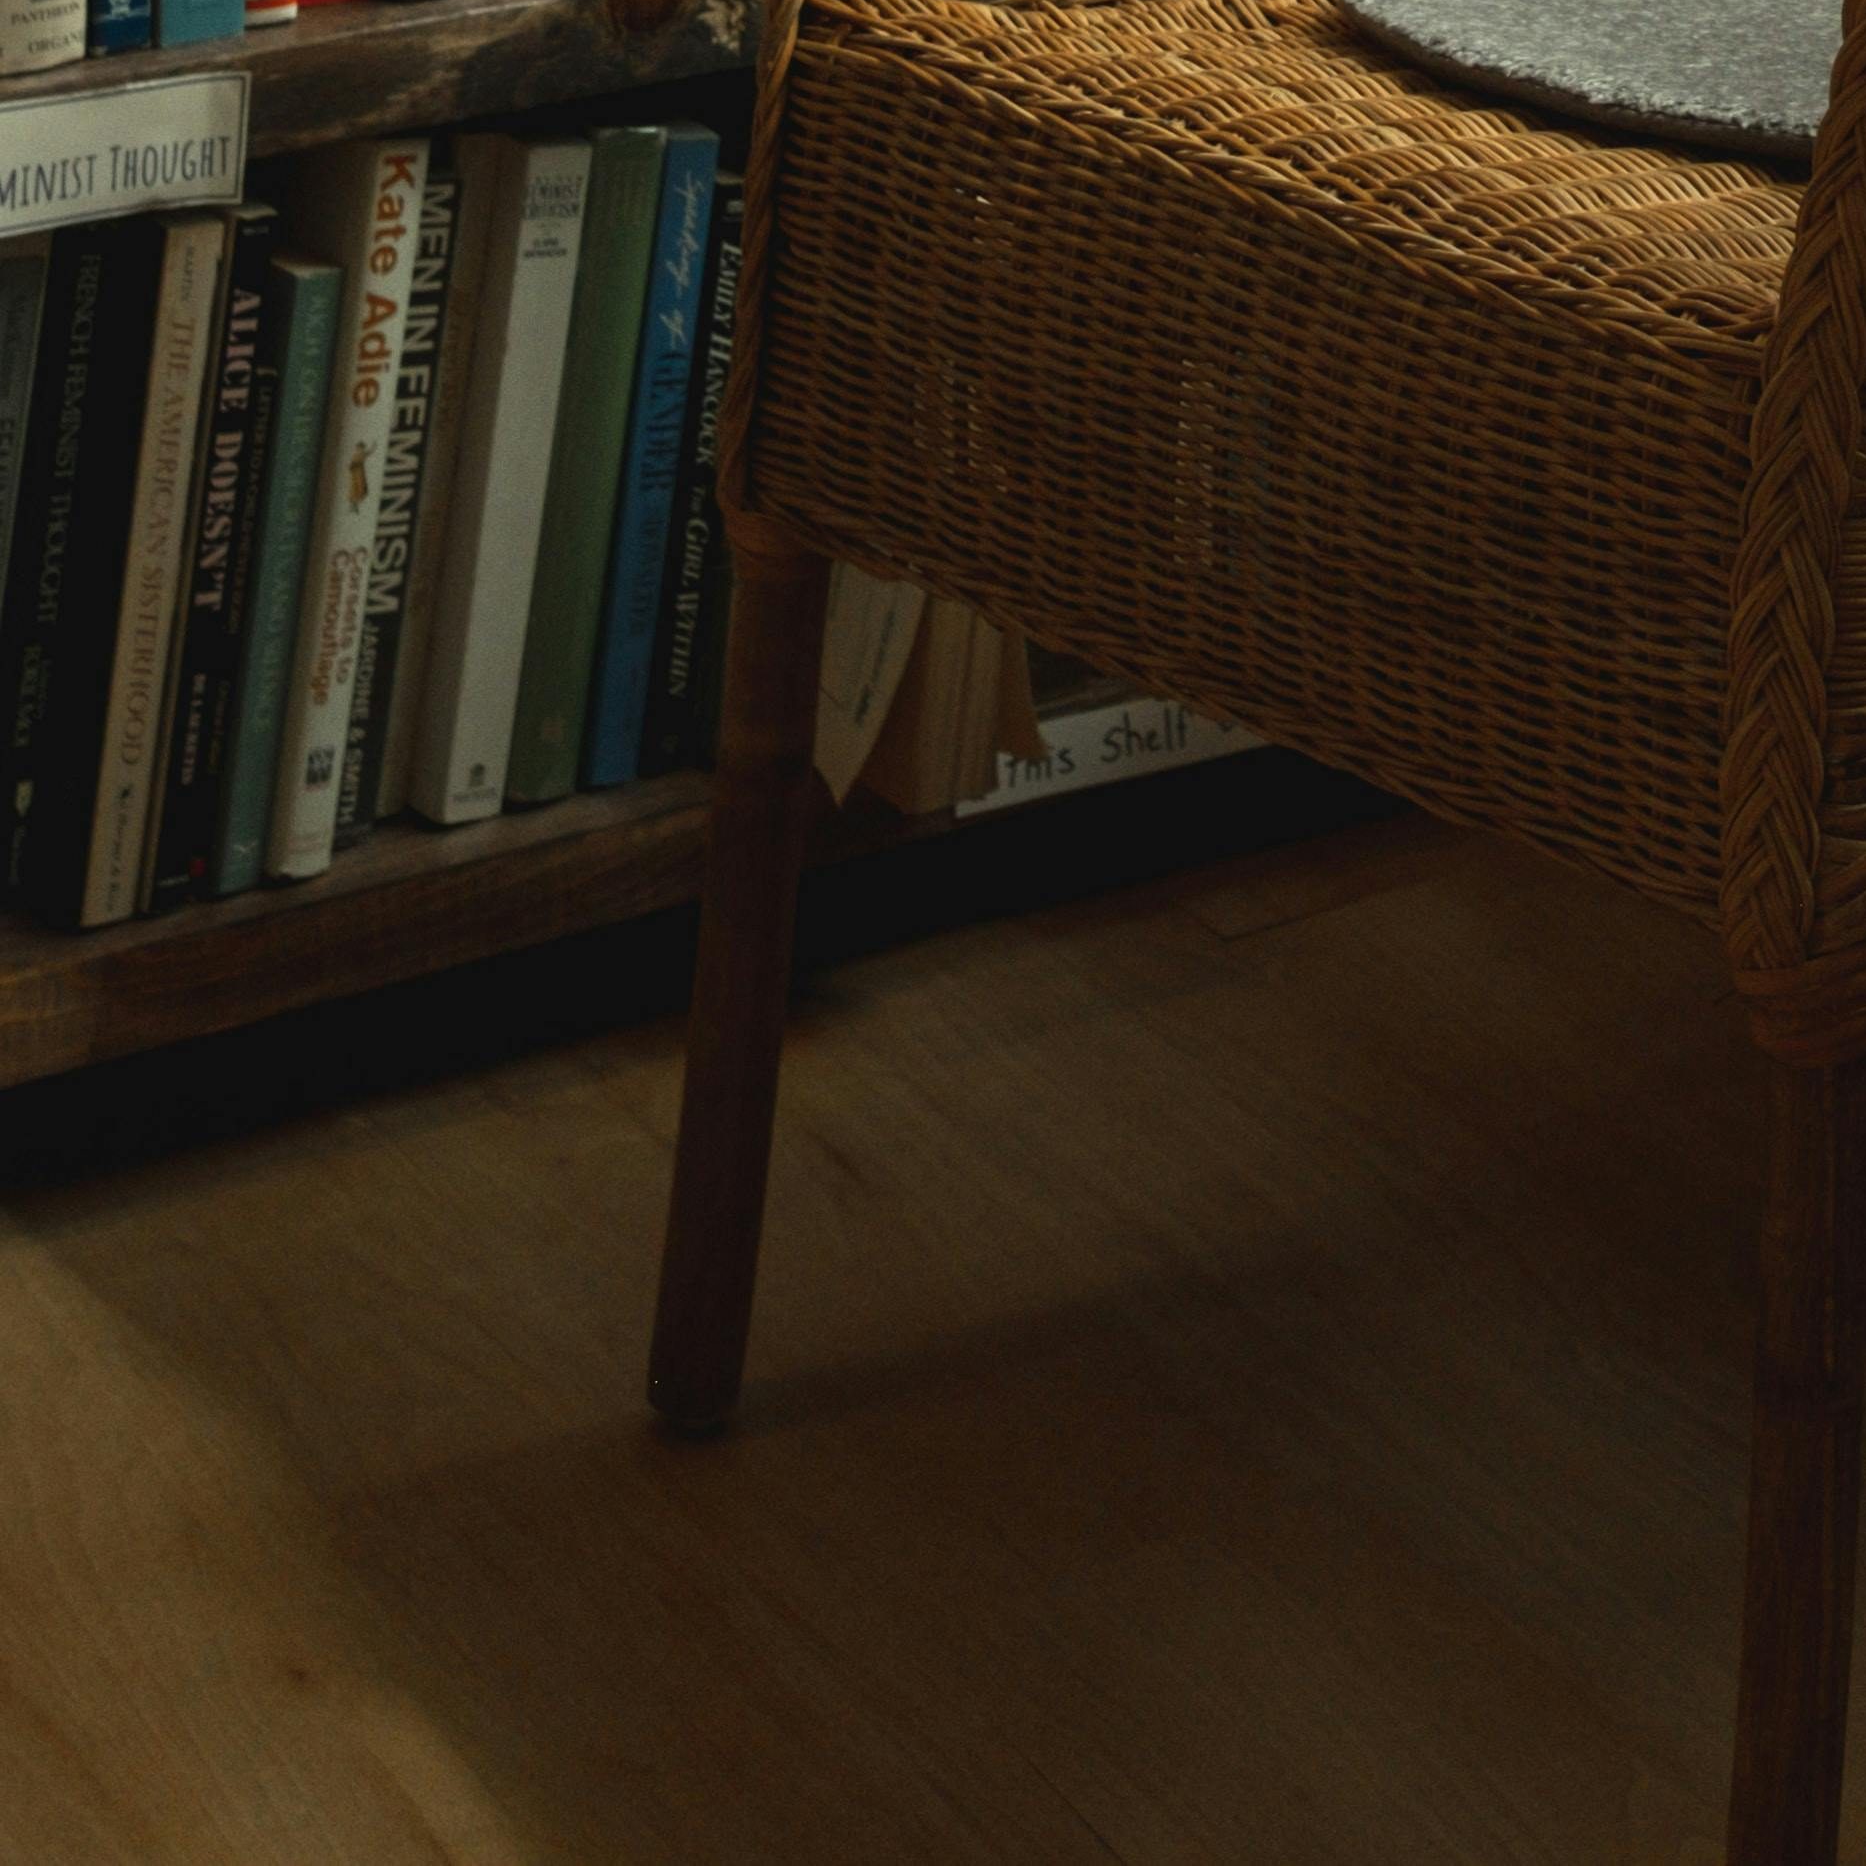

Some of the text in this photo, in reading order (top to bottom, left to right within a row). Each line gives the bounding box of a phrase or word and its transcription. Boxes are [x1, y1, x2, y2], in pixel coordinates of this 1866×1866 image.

[110, 135, 233, 191] THOUGHT
[353, 153, 416, 409] Kate Adie
[195, 286, 263, 613] ALICE DOESN'T
